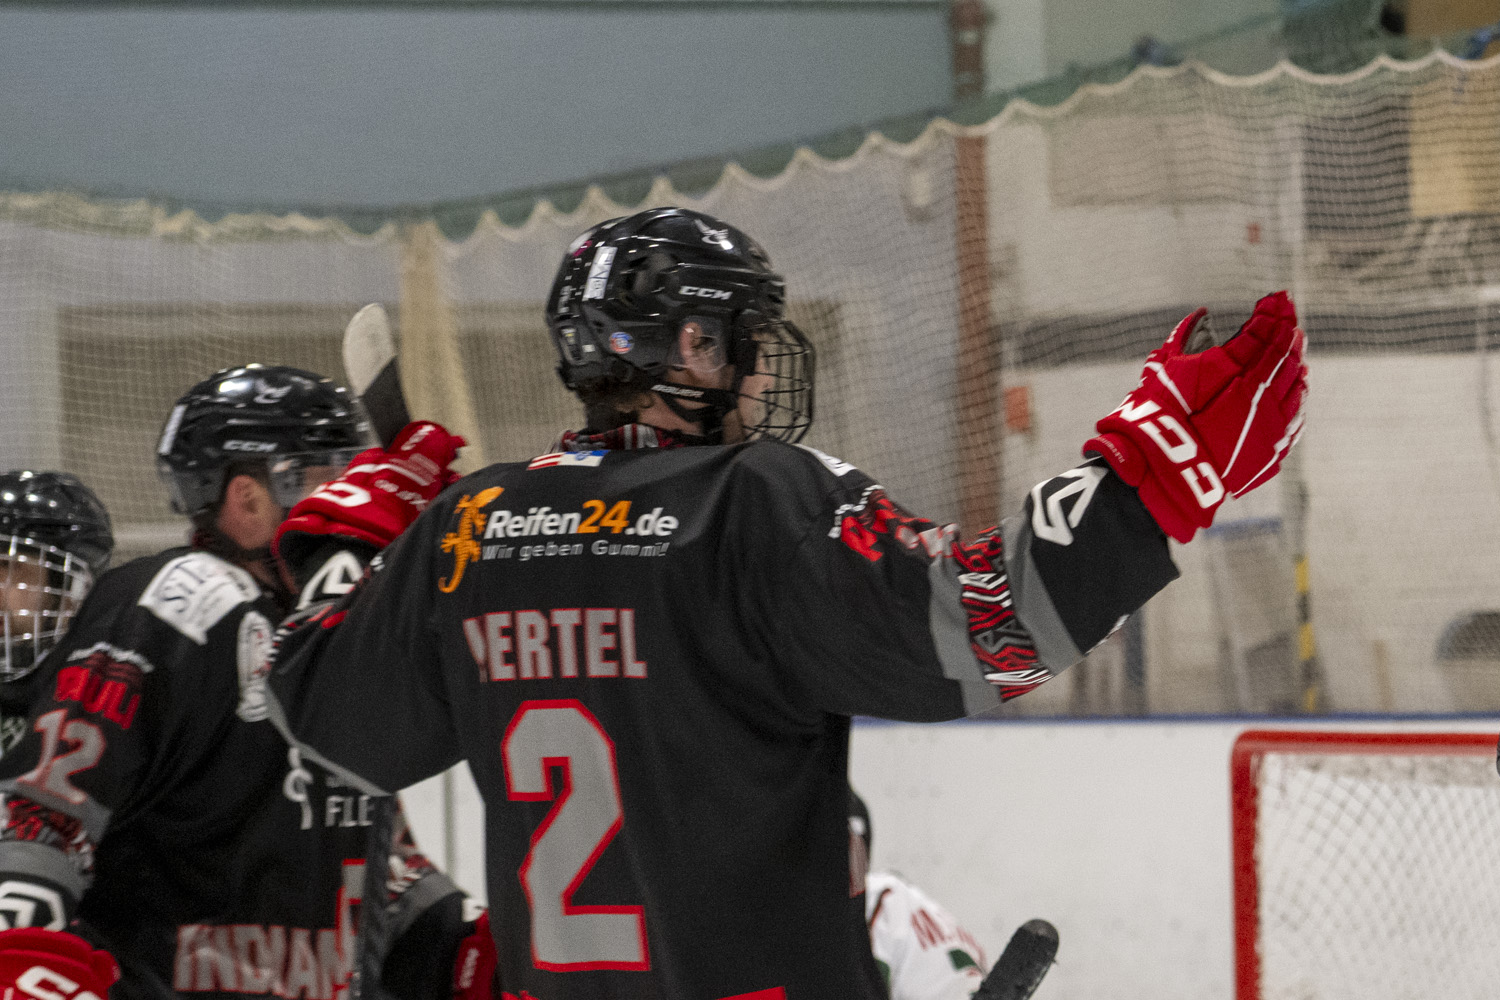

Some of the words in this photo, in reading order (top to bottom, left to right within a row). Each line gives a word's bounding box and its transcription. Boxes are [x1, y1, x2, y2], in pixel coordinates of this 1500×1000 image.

[679, 285, 733, 300] CCM
[223, 439, 278, 453] CCM
[1104, 393, 1226, 509] CCM
[484, 499, 679, 539] Reifen24.de
[482, 545, 514, 560] Wir
[518, 541, 584, 561] geben
[591, 540, 670, 558] Gummi!
[17, 708, 106, 805] 12
[501, 699, 650, 972] 2
